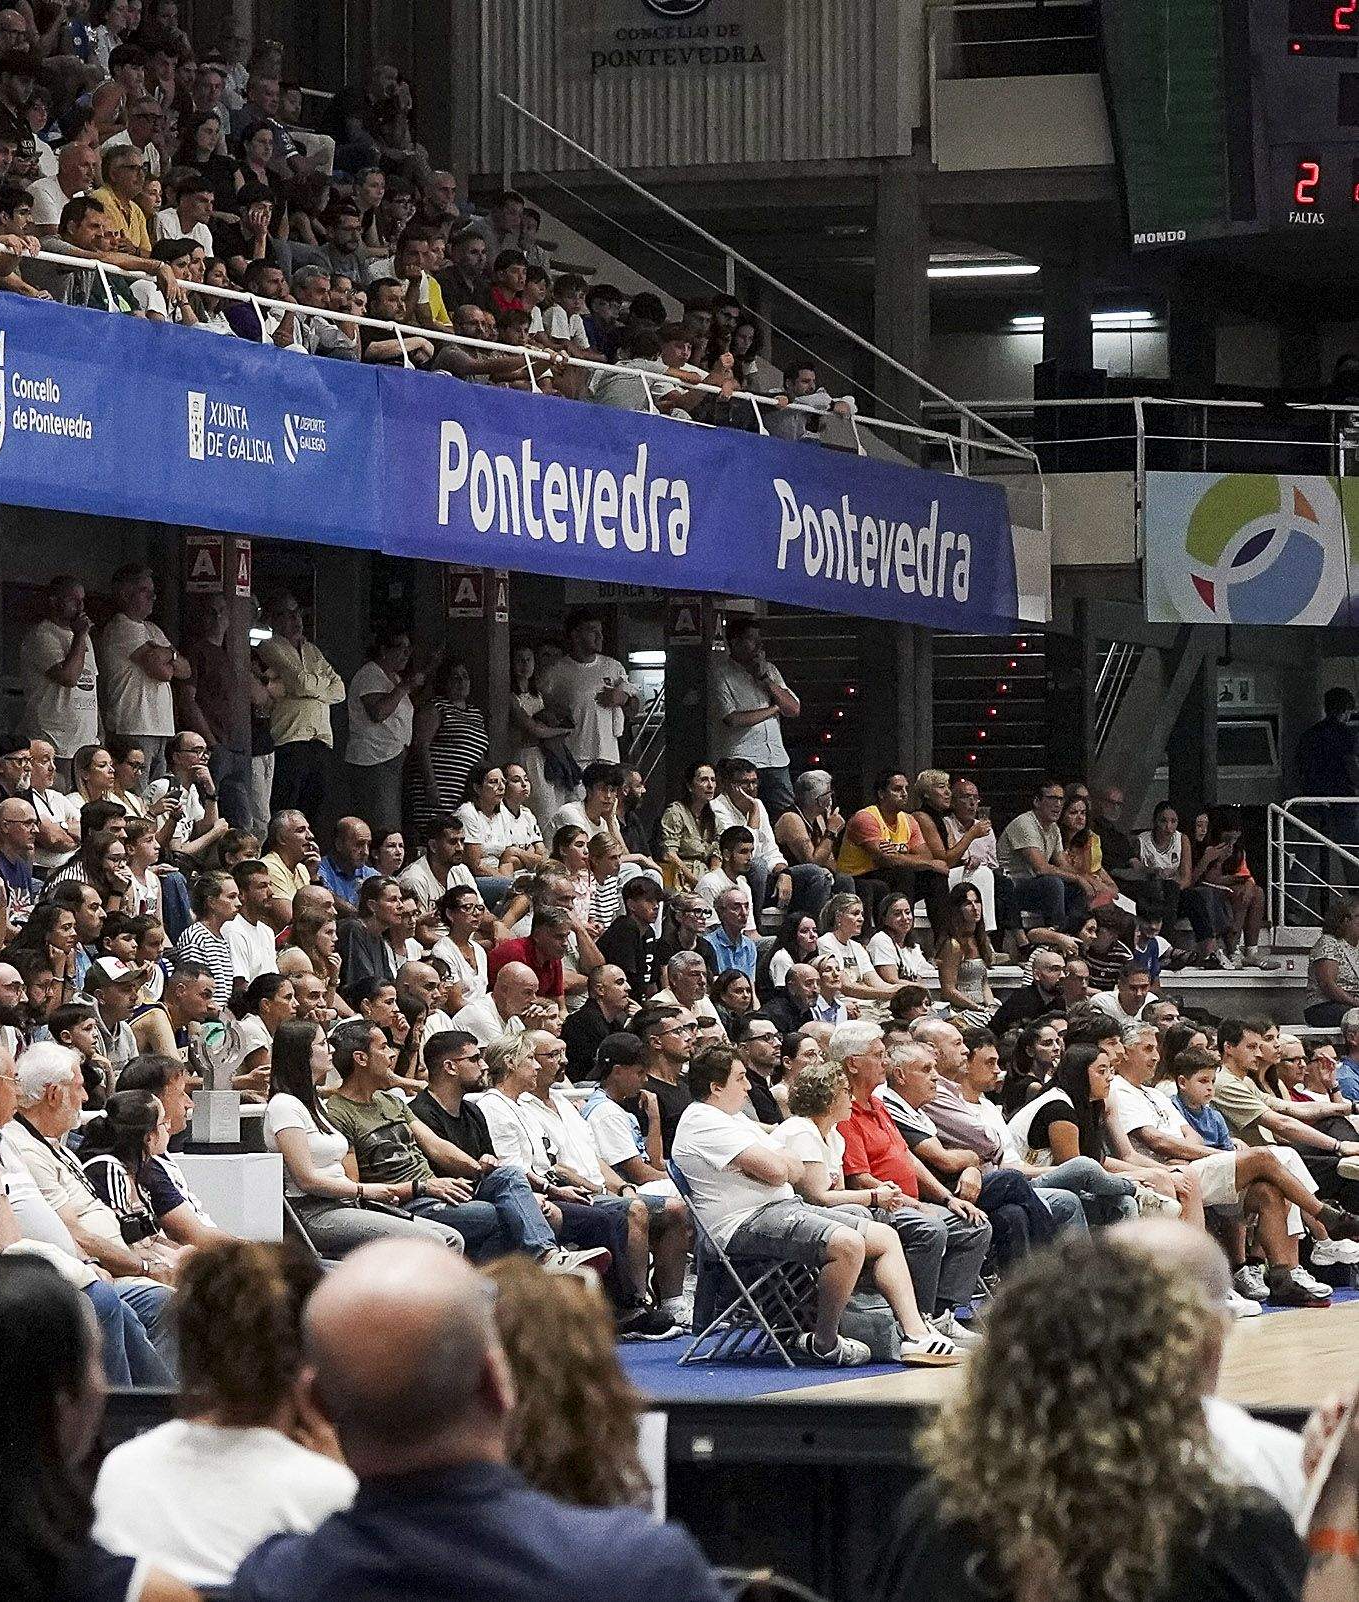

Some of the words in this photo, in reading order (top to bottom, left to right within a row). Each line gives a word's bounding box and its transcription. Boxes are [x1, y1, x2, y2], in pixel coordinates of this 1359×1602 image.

[615, 26, 709, 41] CONCELLO
[716, 23, 740, 38] DE
[591, 41, 766, 75] PONTEVEDRA
[1295, 162, 1320, 204] 2
[1289, 211, 1325, 225] FALTAS
[1133, 230, 1187, 244] MONDO
[11, 371, 61, 404] Concello
[12, 404, 29, 432] de
[29, 406, 93, 440] Pontevedra
[208, 400, 250, 432] XUNTA
[299, 416, 326, 434] DEPORTE
[207, 431, 225, 458] DE
[227, 434, 275, 466] GALICIA
[299, 435, 326, 452] GALEGO
[437, 419, 691, 557] Pontevedra
[772, 477, 972, 603] Pontevedra
[191, 549, 217, 577] A
[238, 553, 248, 581] A
[454, 577, 478, 603] A
[497, 582, 506, 607] A
[675, 608, 696, 632] A
